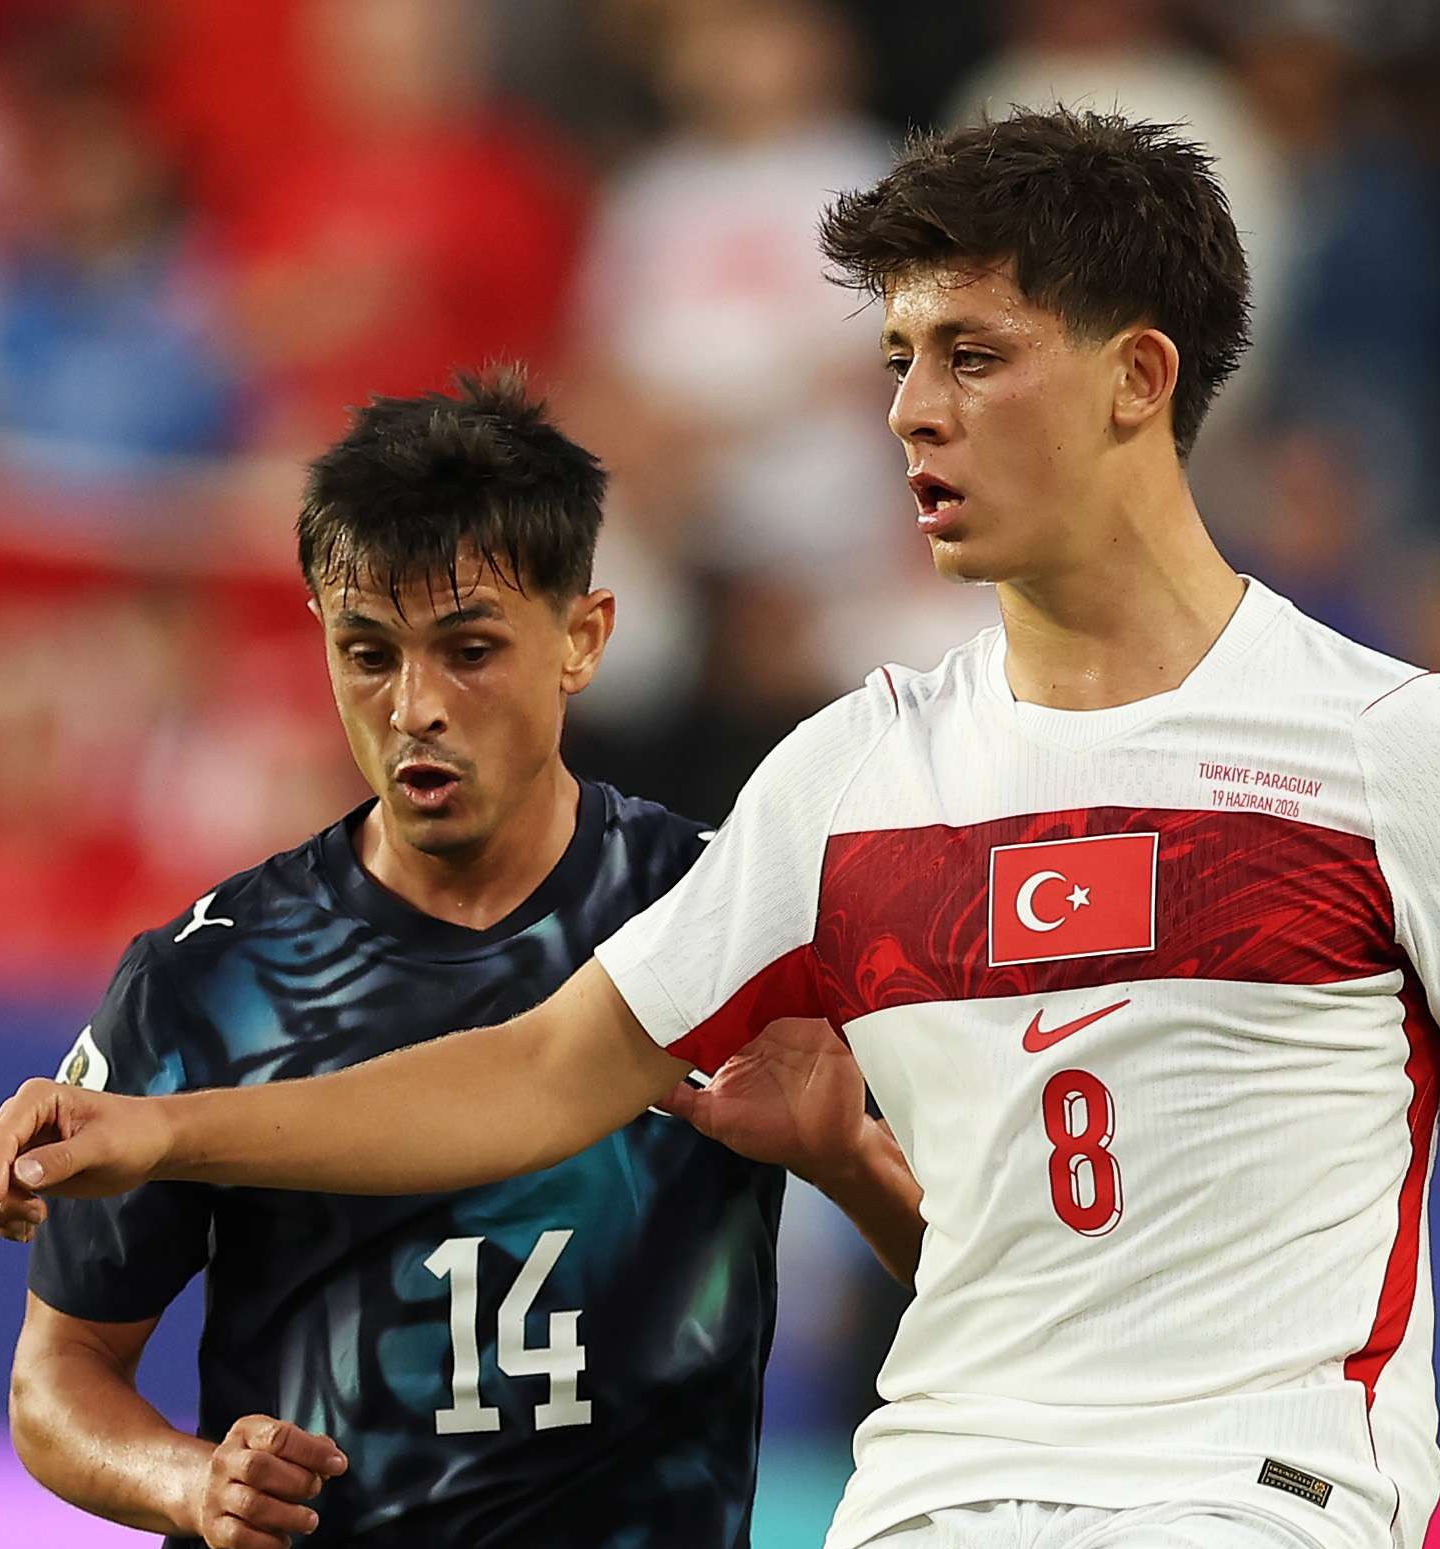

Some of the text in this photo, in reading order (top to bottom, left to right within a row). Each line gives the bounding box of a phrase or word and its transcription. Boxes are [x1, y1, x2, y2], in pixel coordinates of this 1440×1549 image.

[1198, 761, 1323, 798] TÜRKİYE-PARAGUAY
[1212, 789, 1301, 818] 19 HAZİRAN 2026
[1041, 1068, 1124, 1238] 8
[422, 1229, 592, 1435] 14
